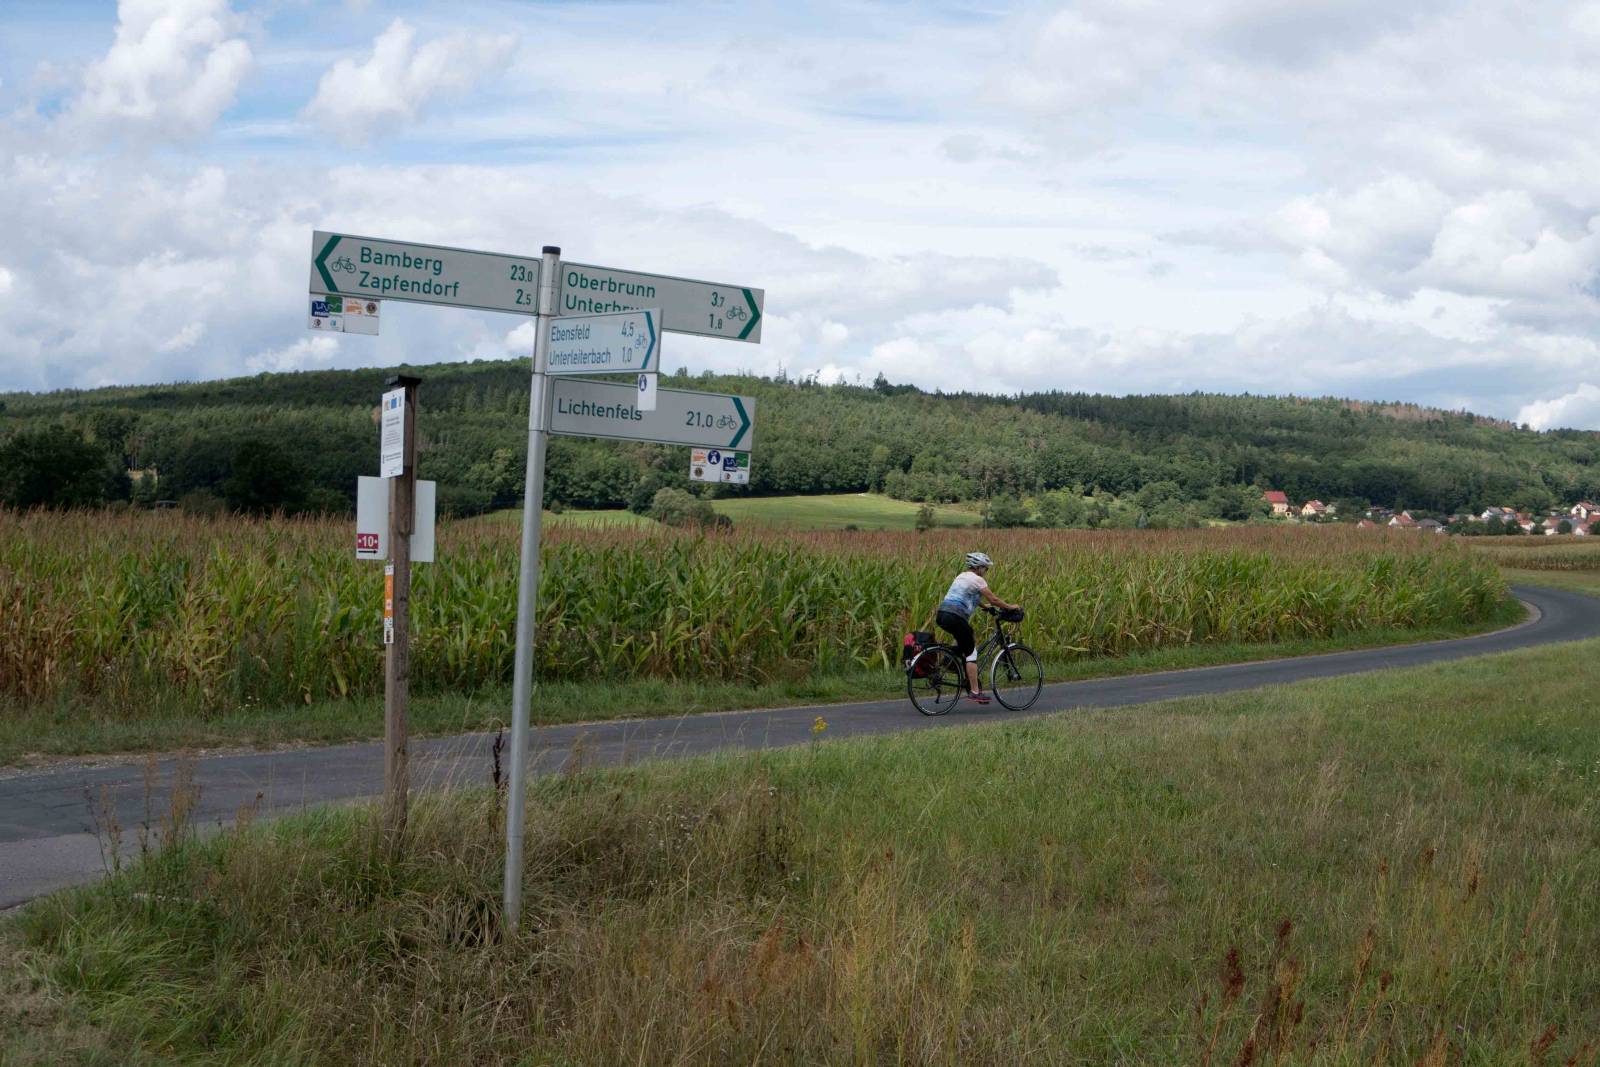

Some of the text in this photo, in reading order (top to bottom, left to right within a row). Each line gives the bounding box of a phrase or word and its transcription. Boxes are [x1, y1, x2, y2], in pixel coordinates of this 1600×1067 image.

[360, 246, 533, 282] Bamberg 23.0
[358, 271, 532, 305] Zapfendorf 2.5
[567, 272, 725, 307] Oberbrunn 3.7
[551, 323, 591, 341] Ebensfeld
[709, 314, 723, 330] 1.8
[549, 347, 611, 366] Unterleiterbach
[558, 398, 714, 428] Lichtenfels 21.0
